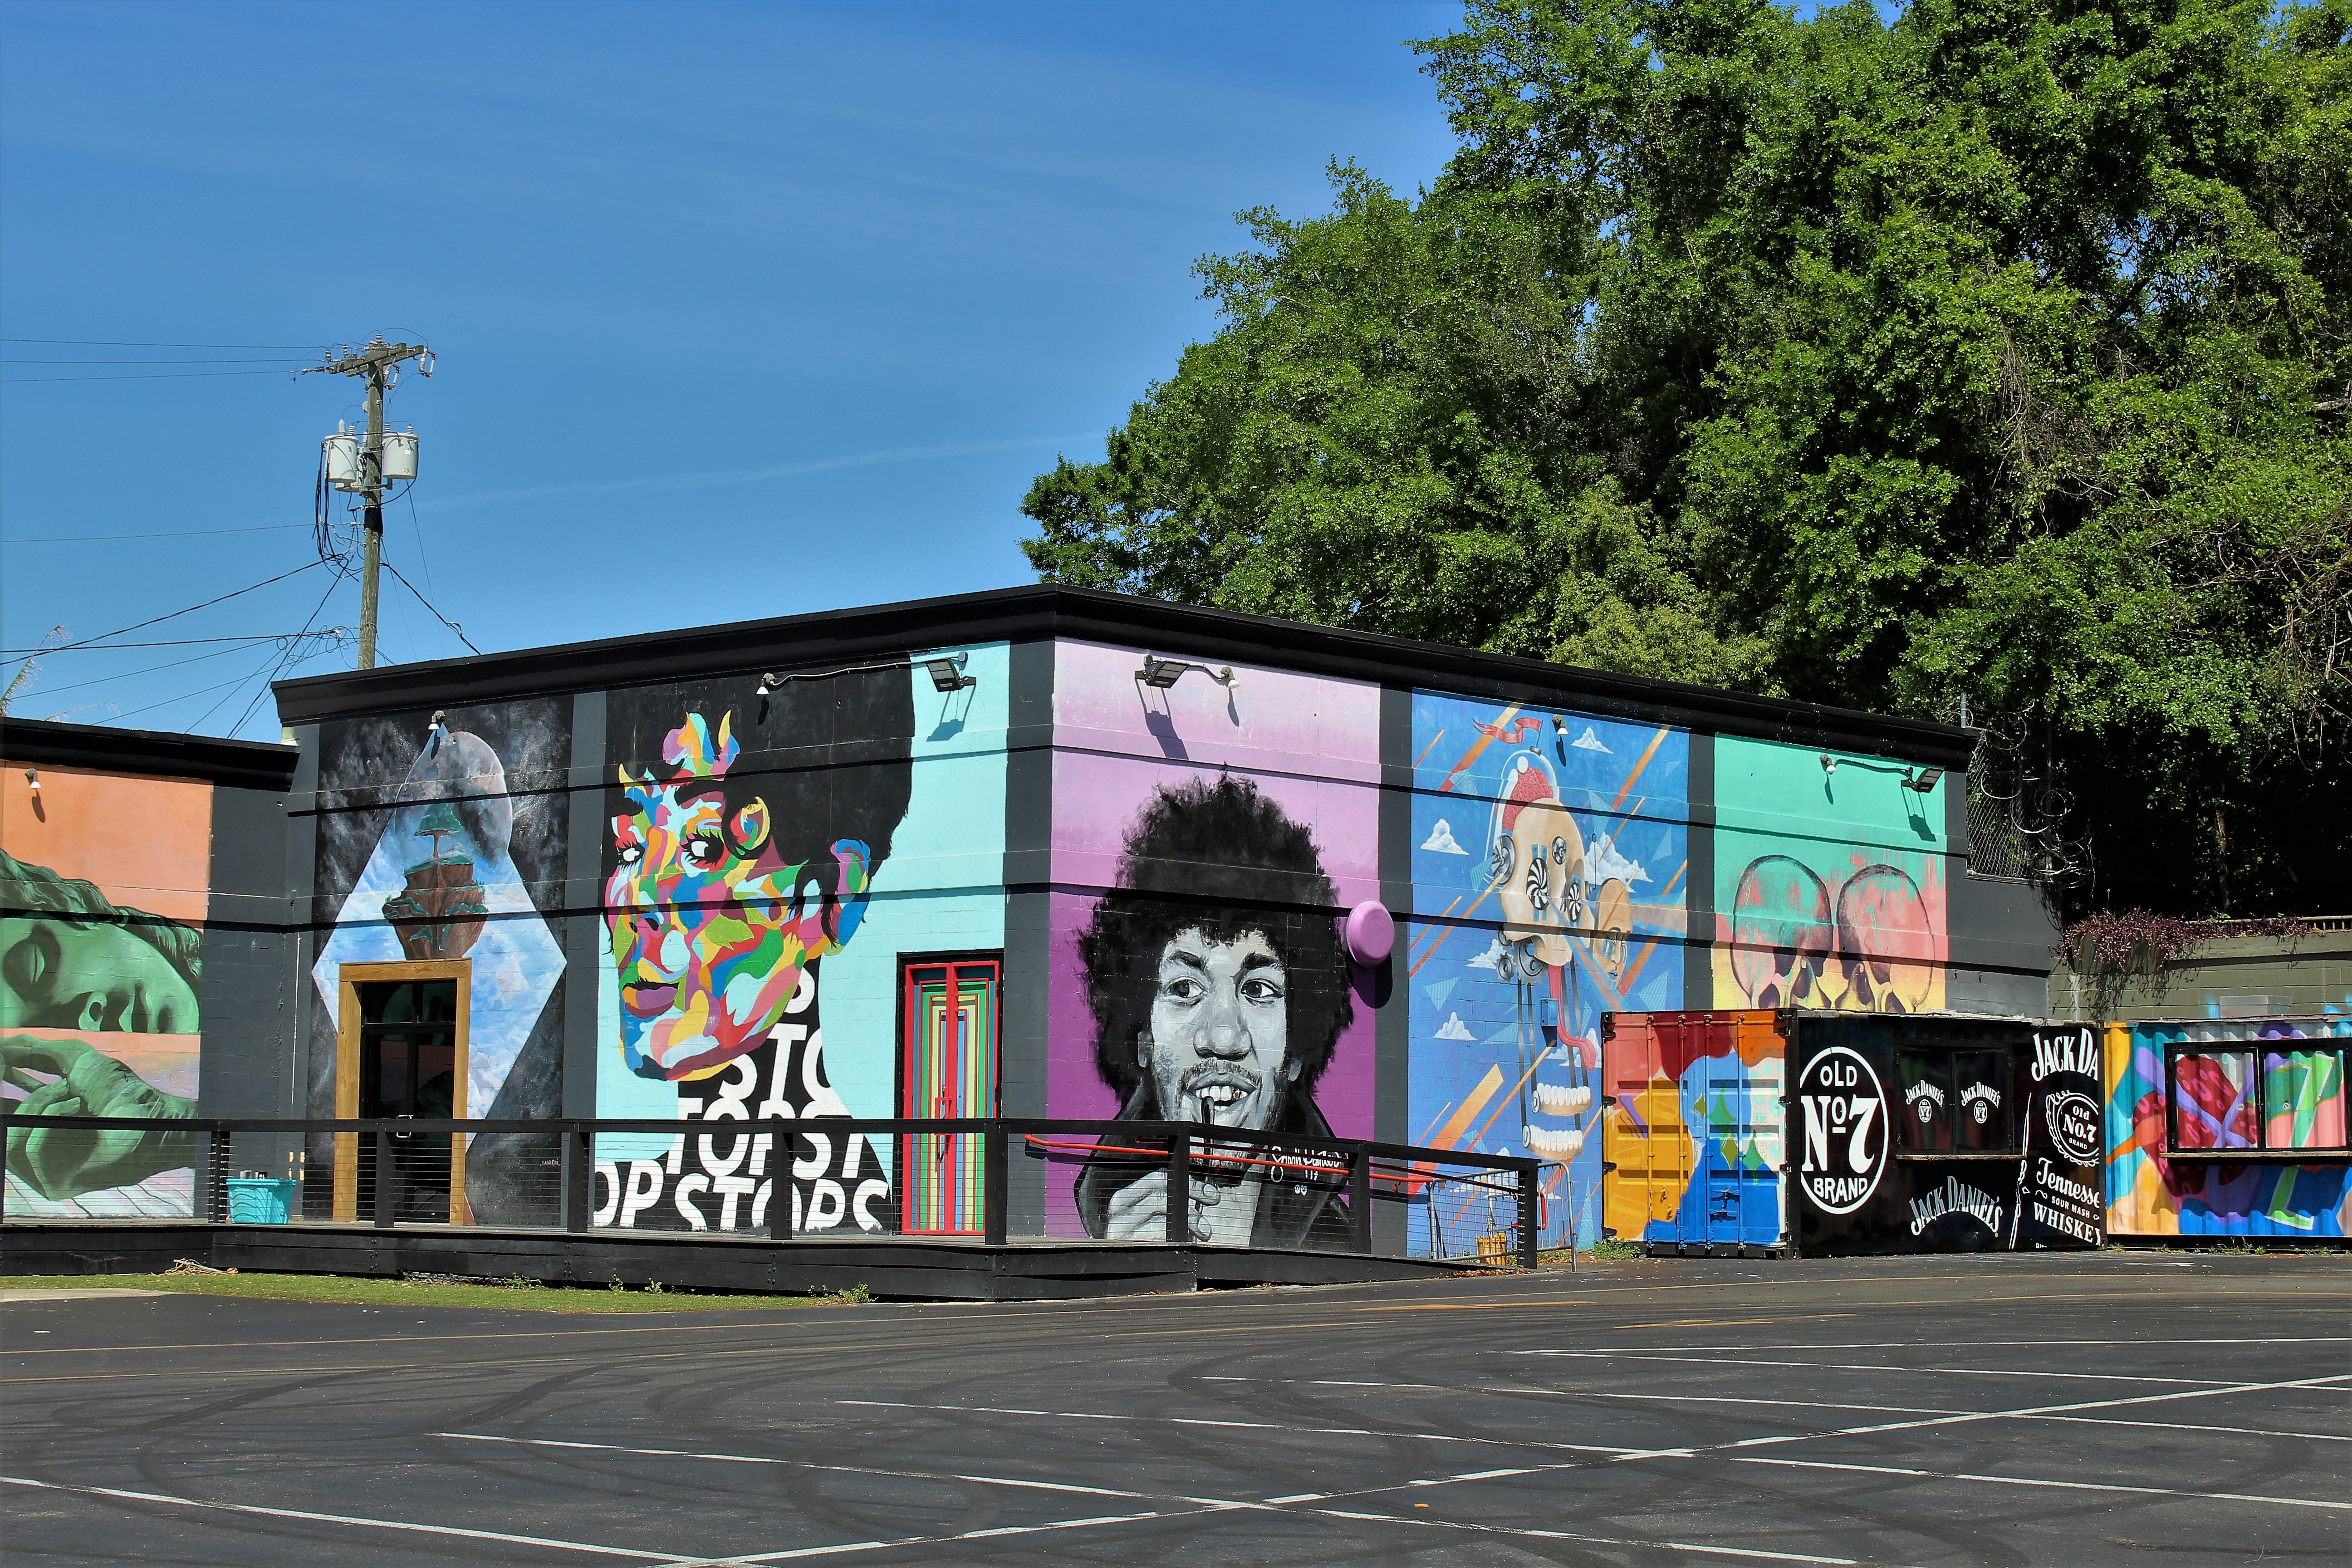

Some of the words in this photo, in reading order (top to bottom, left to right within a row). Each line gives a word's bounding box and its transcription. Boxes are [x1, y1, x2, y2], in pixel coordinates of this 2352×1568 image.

[2031, 1033, 2076, 1082] JACK
[1820, 1061, 1857, 1087] OLD
[1905, 1084, 1921, 1105] JACK
[1960, 1085, 1977, 1106] JACK
[2069, 1137, 2087, 1150] BRAND
[1814, 1177, 1868, 1205] BRAND
[1909, 1186, 1947, 1236] JACK
[1946, 1176, 2003, 1233] DANIEL'S
[2051, 1196, 2069, 1210] SOUR
[2071, 1204, 2090, 1219] MASH
